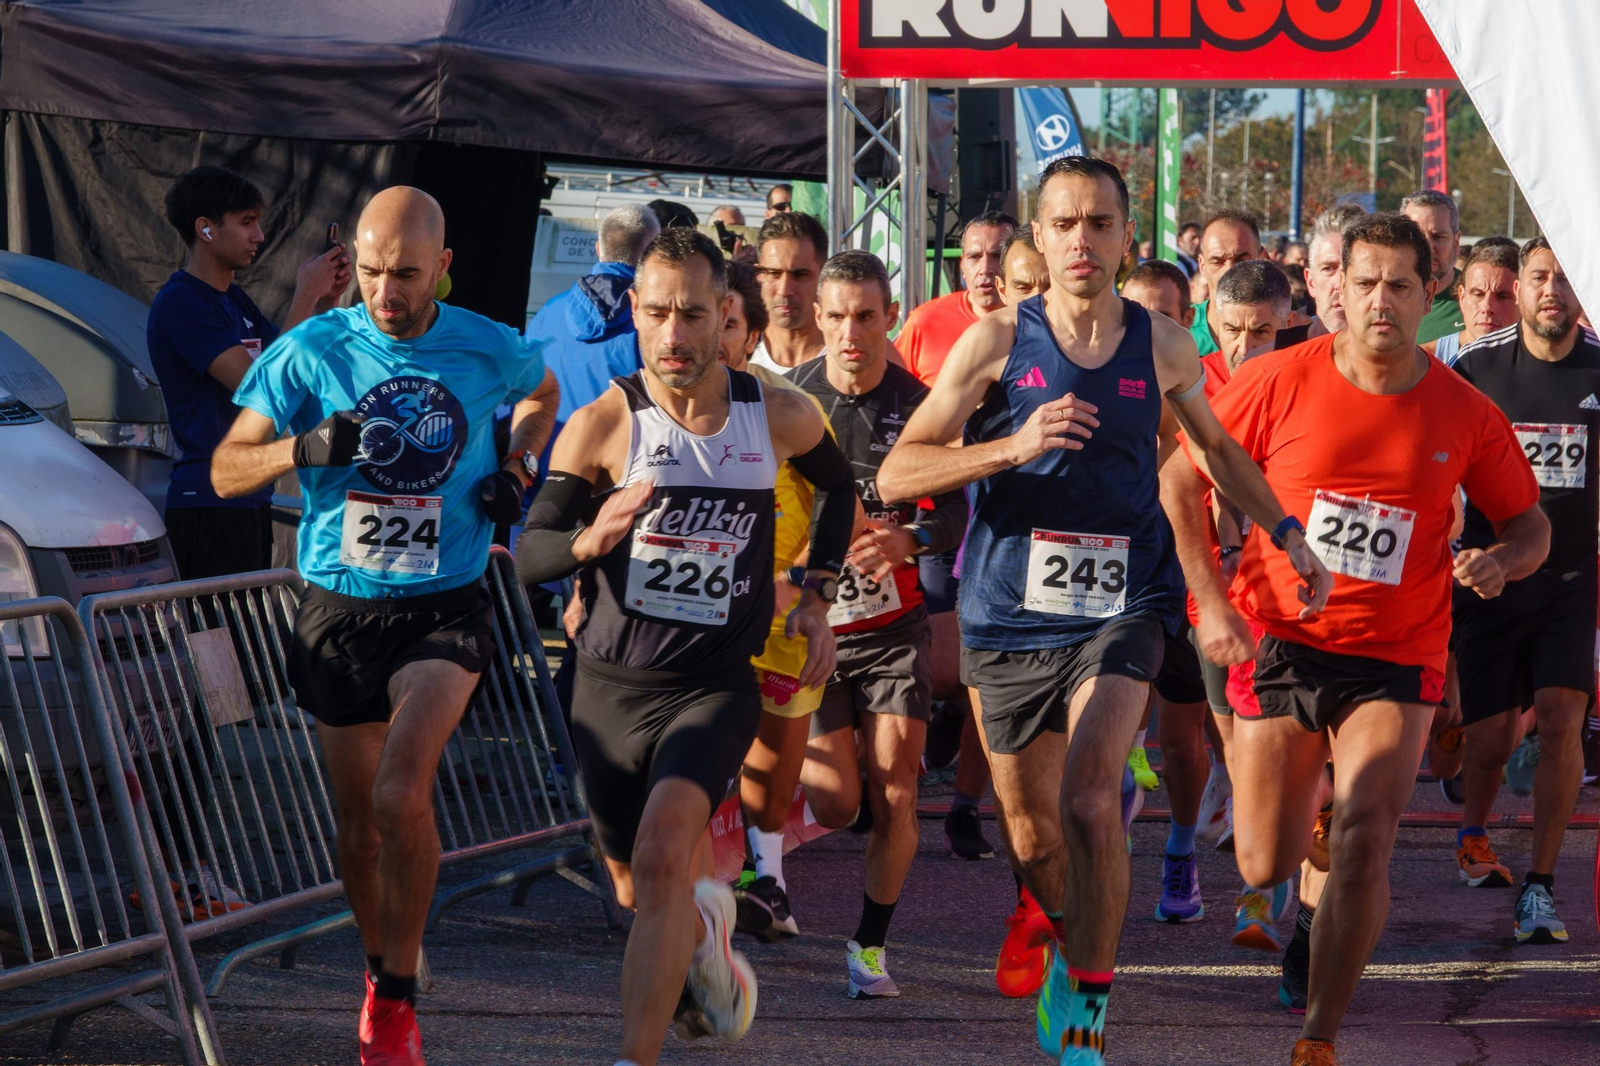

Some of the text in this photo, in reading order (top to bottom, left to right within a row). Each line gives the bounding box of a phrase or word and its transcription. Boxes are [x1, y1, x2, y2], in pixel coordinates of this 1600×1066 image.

[562, 236, 596, 247] CONC
[568, 247, 597, 257] DE V
[379, 380, 446, 401] RUNNERS
[1524, 441, 1585, 469] 229
[369, 467, 443, 490] AND BIKERS
[357, 514, 440, 550] 224
[640, 496, 757, 539] delikia
[1317, 516, 1397, 559] 220
[644, 558, 730, 600] 226
[836, 569, 882, 602] 33
[1042, 555, 1126, 594] 243
